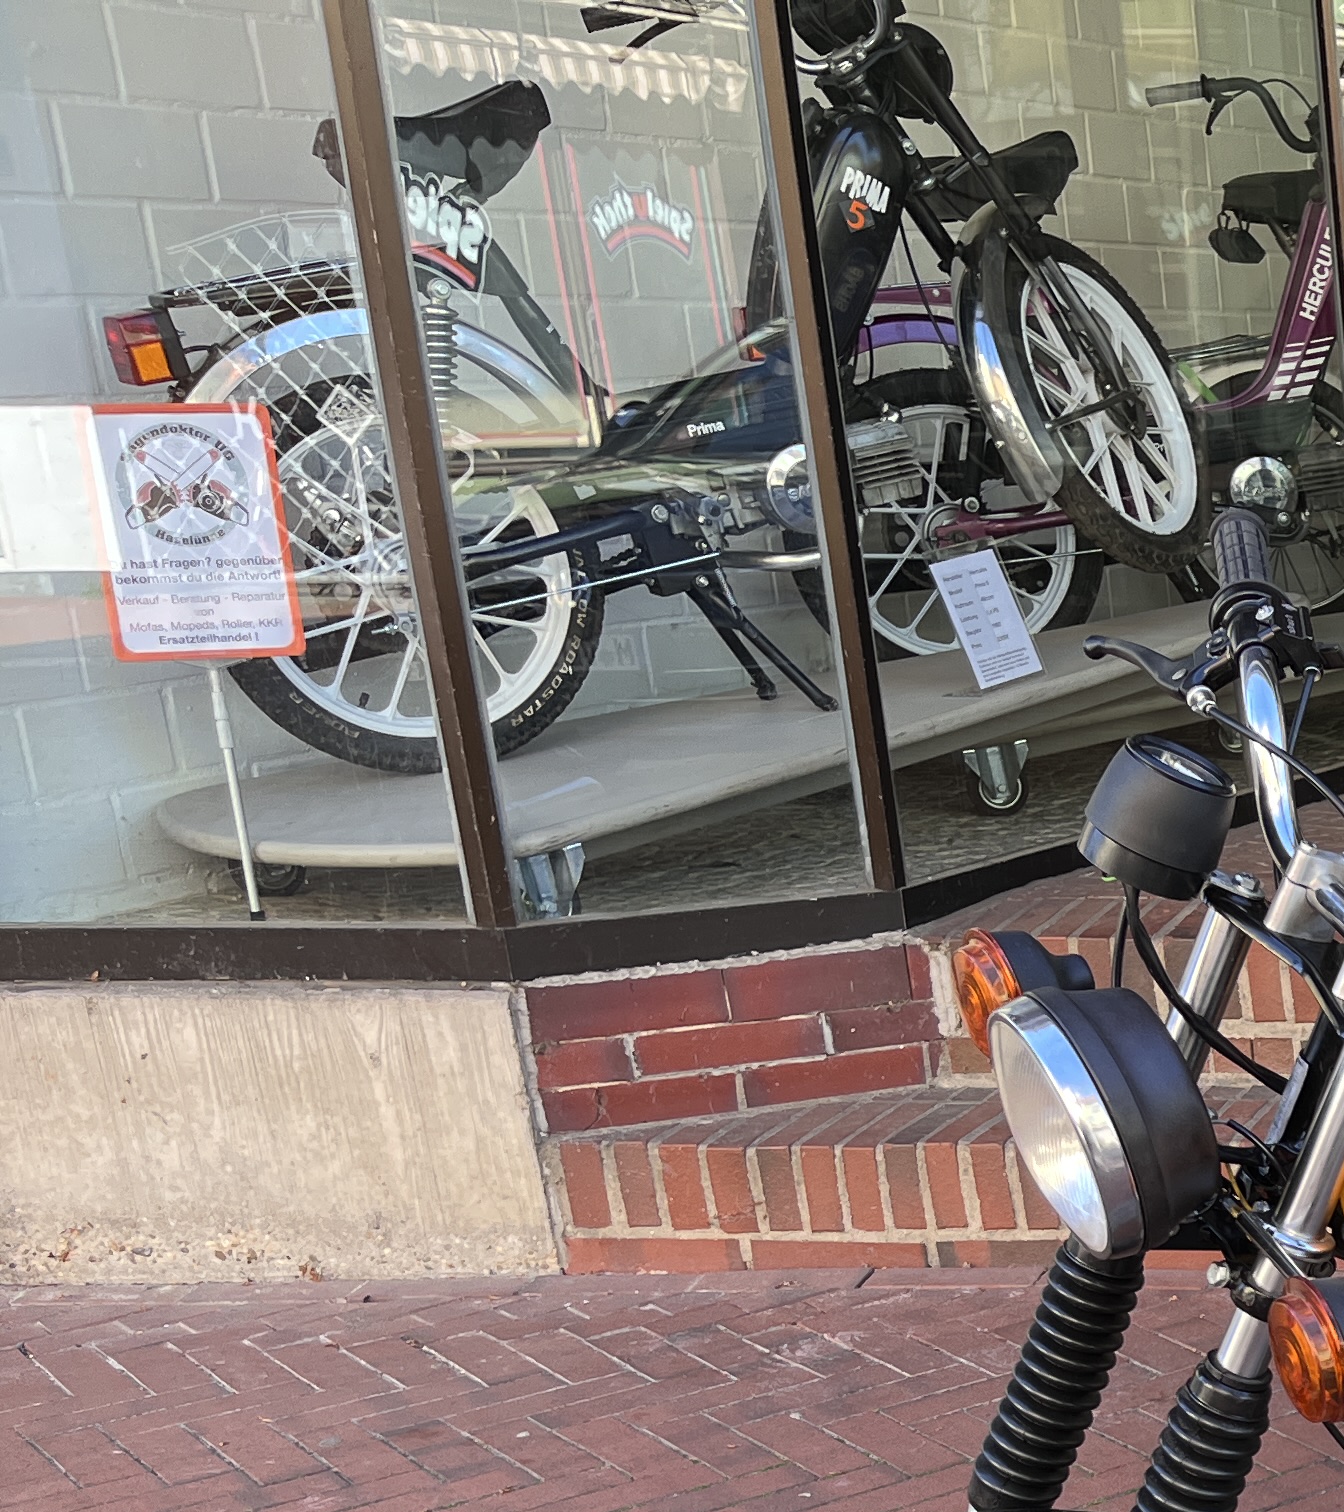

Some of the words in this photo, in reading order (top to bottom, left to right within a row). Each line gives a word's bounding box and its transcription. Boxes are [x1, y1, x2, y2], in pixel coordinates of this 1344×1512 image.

[840, 166, 890, 213] PRIMA
[846, 200, 868, 231] 5
[686, 421, 726, 438] Prima
[130, 559, 159, 570] hast
[161, 556, 211, 570] Fragen?
[215, 555, 284, 569] gegenüber
[115, 574, 184, 585] bekommst
[186, 573, 203, 583] du
[205, 571, 225, 582] die
[118, 594, 160, 606] Verkauf
[158, 631, 252, 645] Ersatzteilhandel
